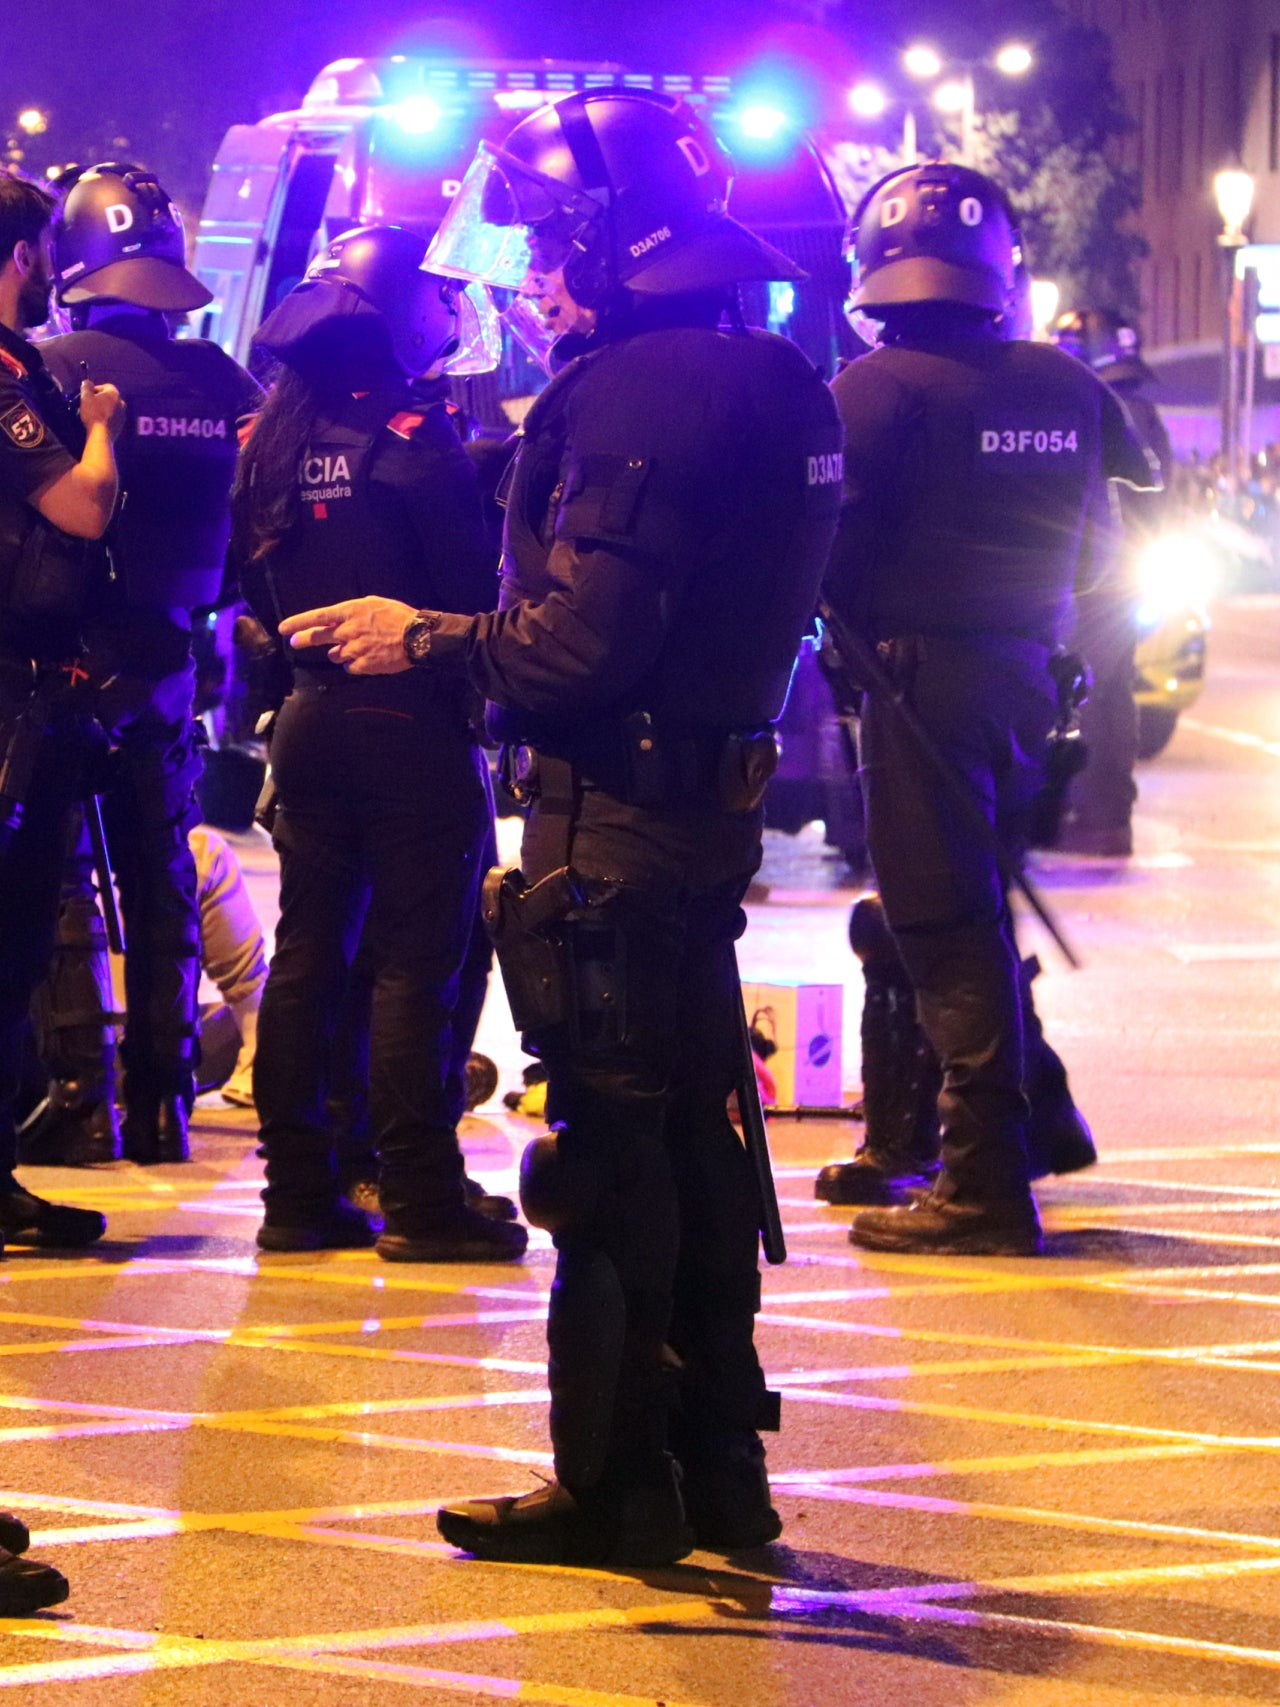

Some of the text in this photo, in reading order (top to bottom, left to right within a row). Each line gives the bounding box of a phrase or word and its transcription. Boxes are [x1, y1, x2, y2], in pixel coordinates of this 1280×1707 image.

[676, 136, 710, 177] D
[104, 204, 134, 233] D
[881, 197, 908, 228] D
[11, 413, 34, 441] 57
[137, 416, 227, 439] D3H404
[981, 430, 1079, 453] D3F054
[807, 453, 844, 486] D3A7
